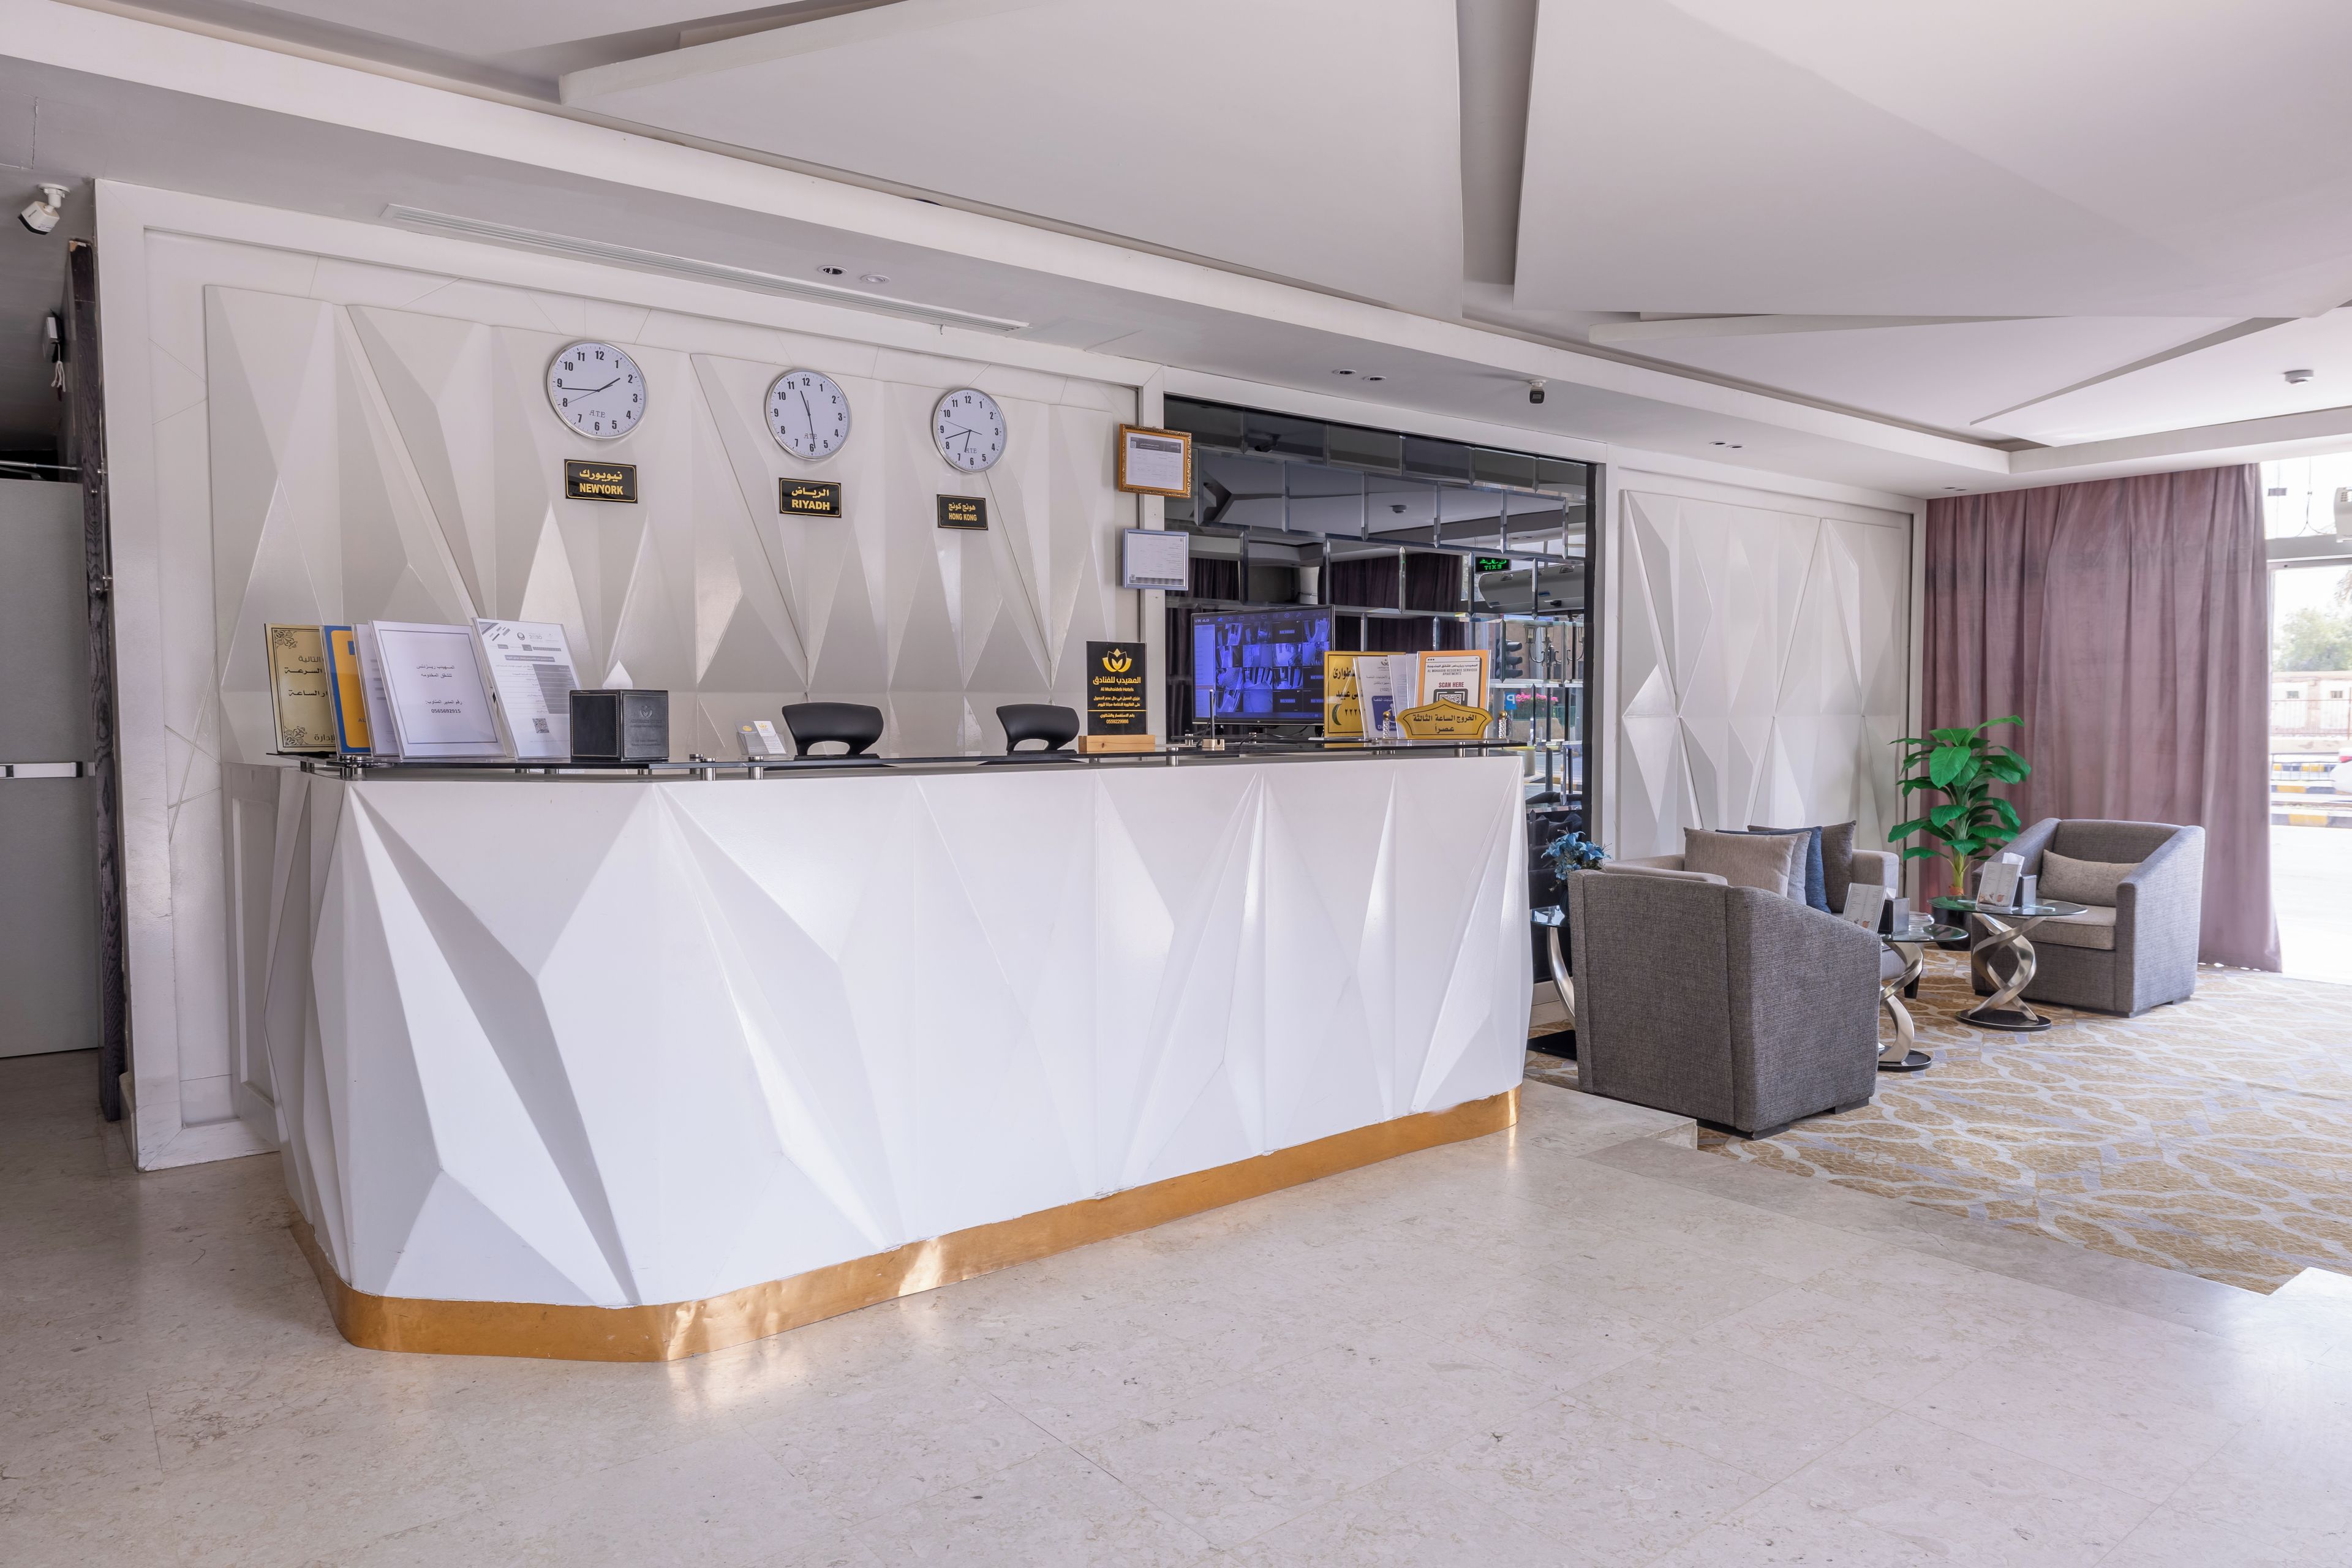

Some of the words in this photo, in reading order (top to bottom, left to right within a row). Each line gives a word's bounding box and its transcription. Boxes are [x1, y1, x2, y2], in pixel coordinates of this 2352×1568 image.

[577, 352, 586, 361] 11
[595, 350, 604, 361] 12
[564, 361, 573, 371] 10
[615, 360, 619, 369] 1
[628, 374, 633, 383] 2
[557, 379, 562, 388] 9
[787, 381, 794, 390] 11
[633, 394, 638, 402] 3
[777, 391, 786, 400] 10
[562, 398, 568, 407] 8
[626, 410, 631, 420] 4
[774, 408, 778, 417] 9
[578, 414, 582, 423] 7
[594, 421, 600, 431] 6
[612, 420, 617, 429] 5
[781, 426, 785, 434] 8
[834, 429, 839, 437] 4
[810, 443, 814, 452] 6
[824, 440, 828, 448] 5
[579, 469, 623, 481] نيويورك
[579, 483, 624, 495] NEWYORK
[791, 486, 829, 498] الرياض
[791, 499, 830, 510] RIYADH
[949, 502, 962, 511] كونج
[962, 503, 976, 511] هونج
[1093, 676, 1115, 685] للفنادق
[1456, 714, 1477, 723] الخروج
